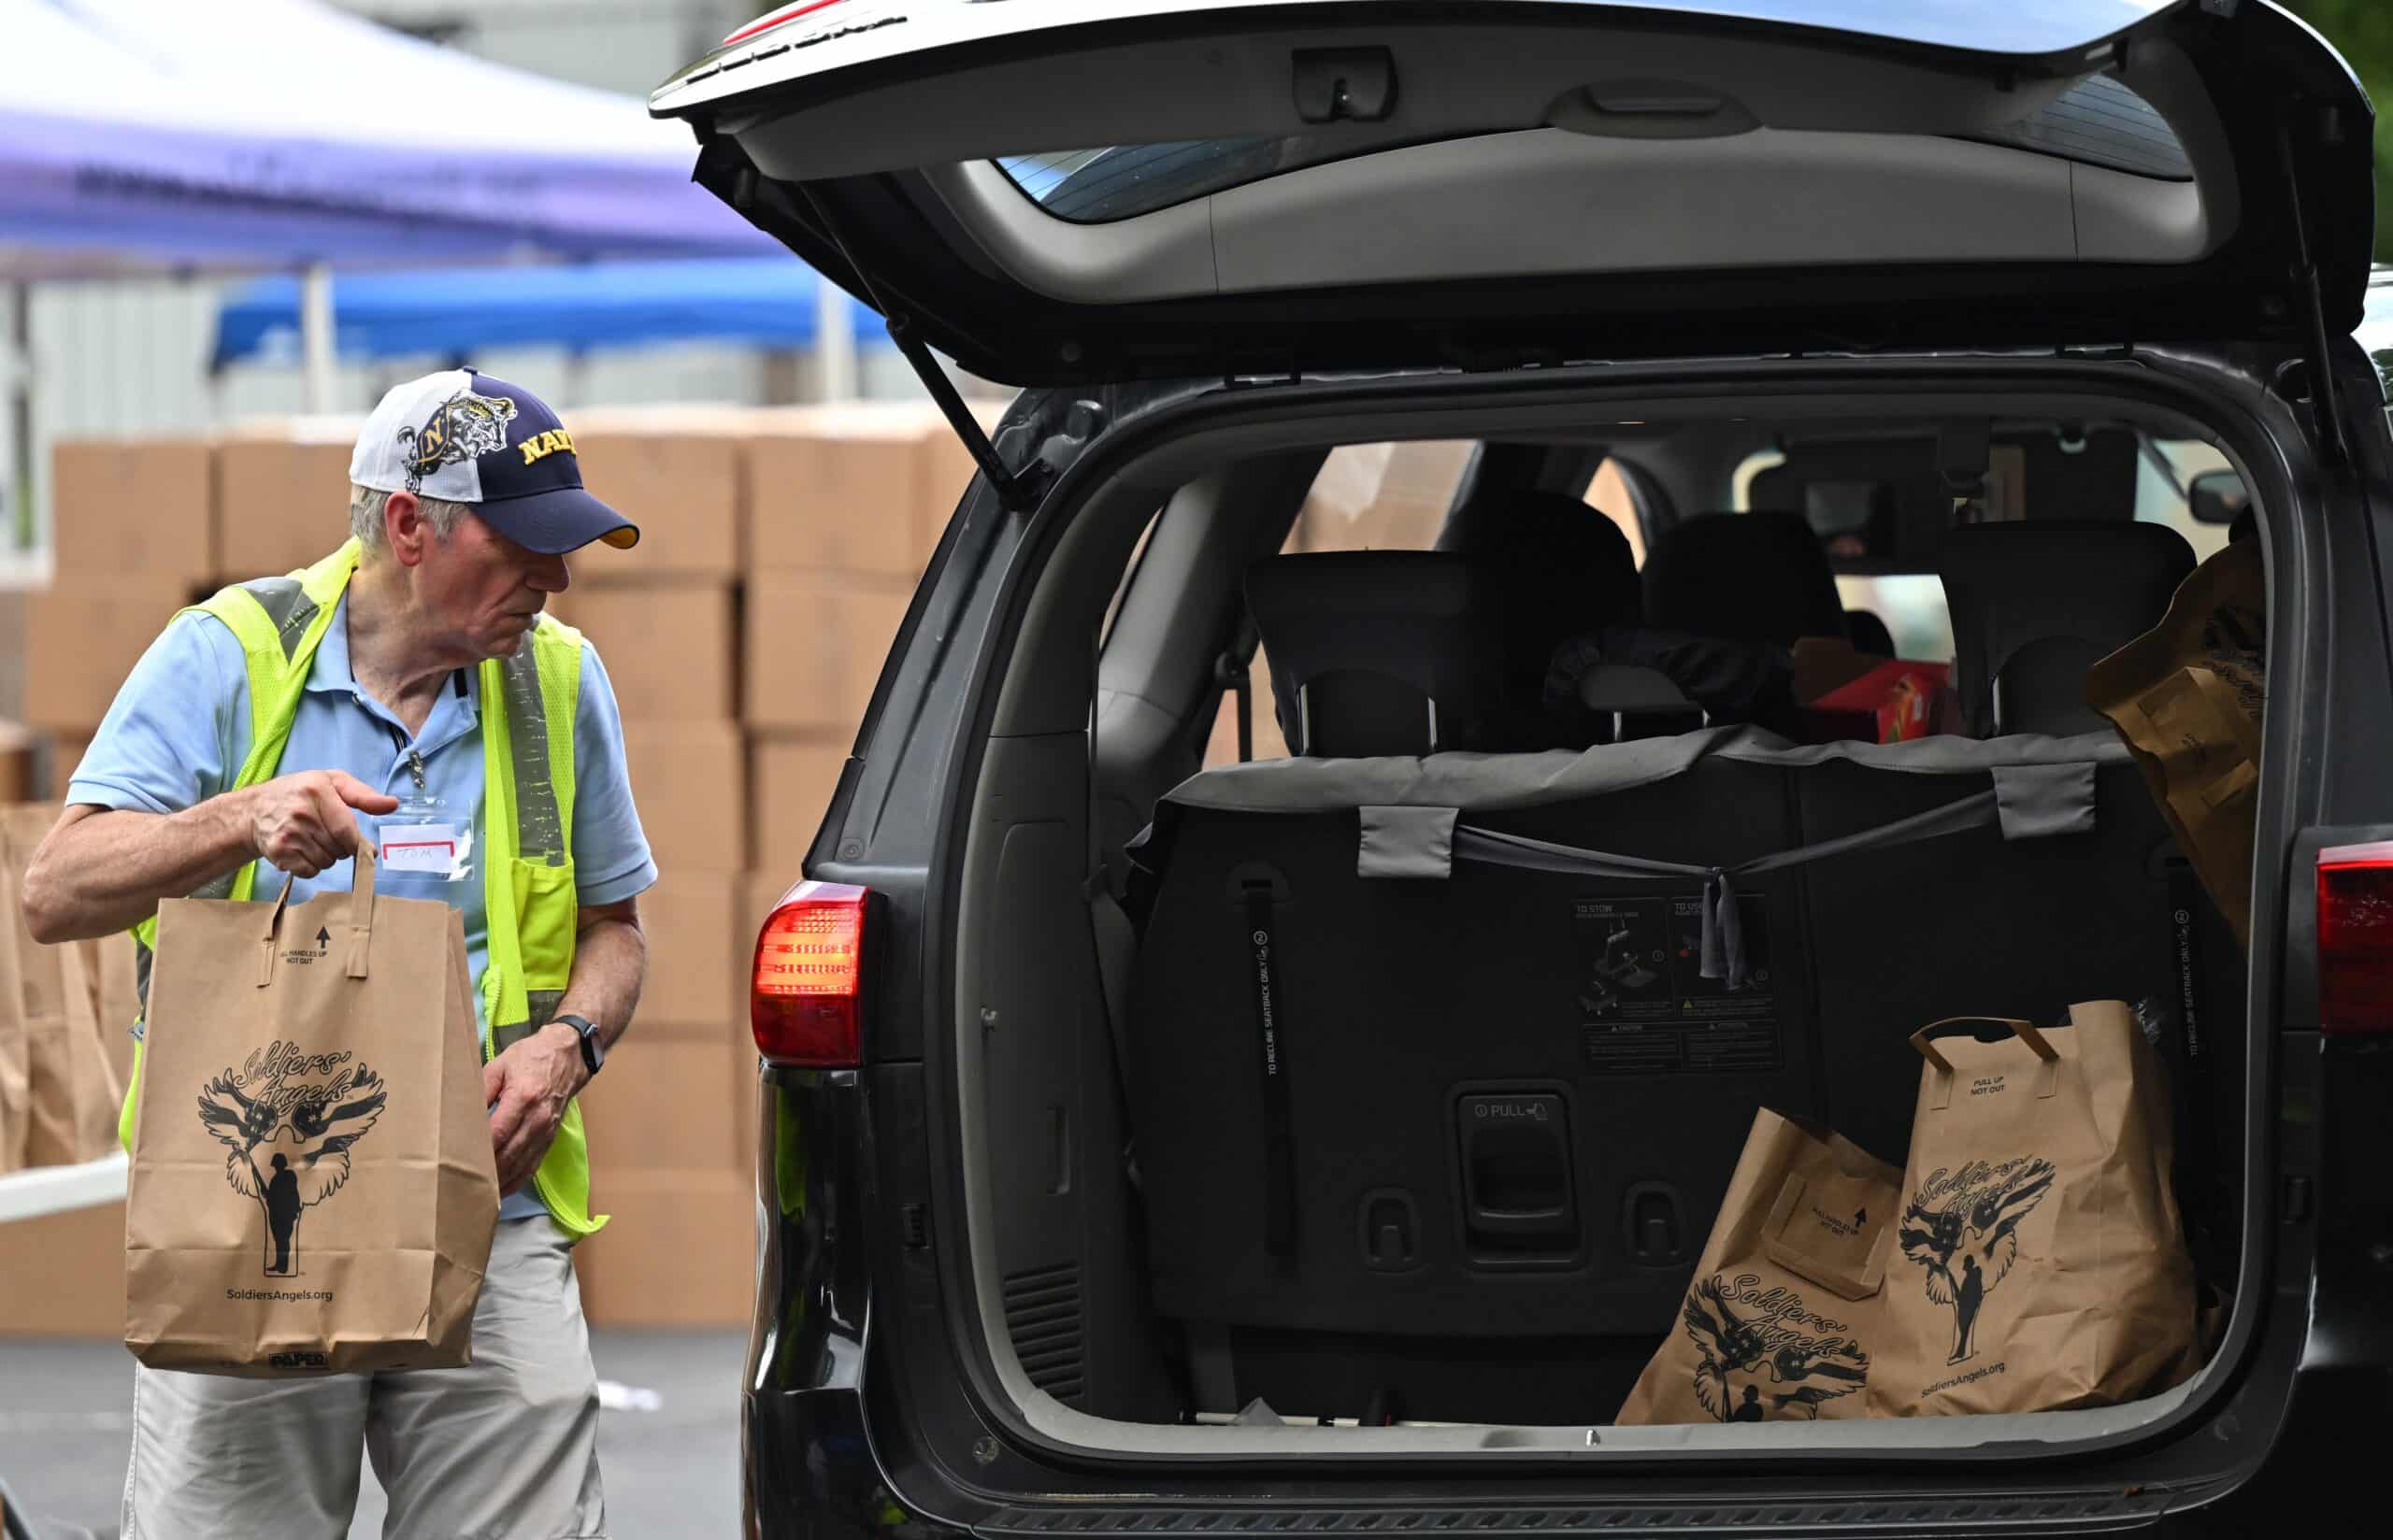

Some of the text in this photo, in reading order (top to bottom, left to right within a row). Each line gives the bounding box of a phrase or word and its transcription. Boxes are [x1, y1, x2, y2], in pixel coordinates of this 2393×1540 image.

[425, 418, 443, 452] N
[1490, 1105, 1526, 1118] PULL
[226, 1289, 334, 1303] SoldiersAngels.org
[1719, 1274, 1848, 1333] Soldiers'
[1737, 1313, 1844, 1359] Angels
